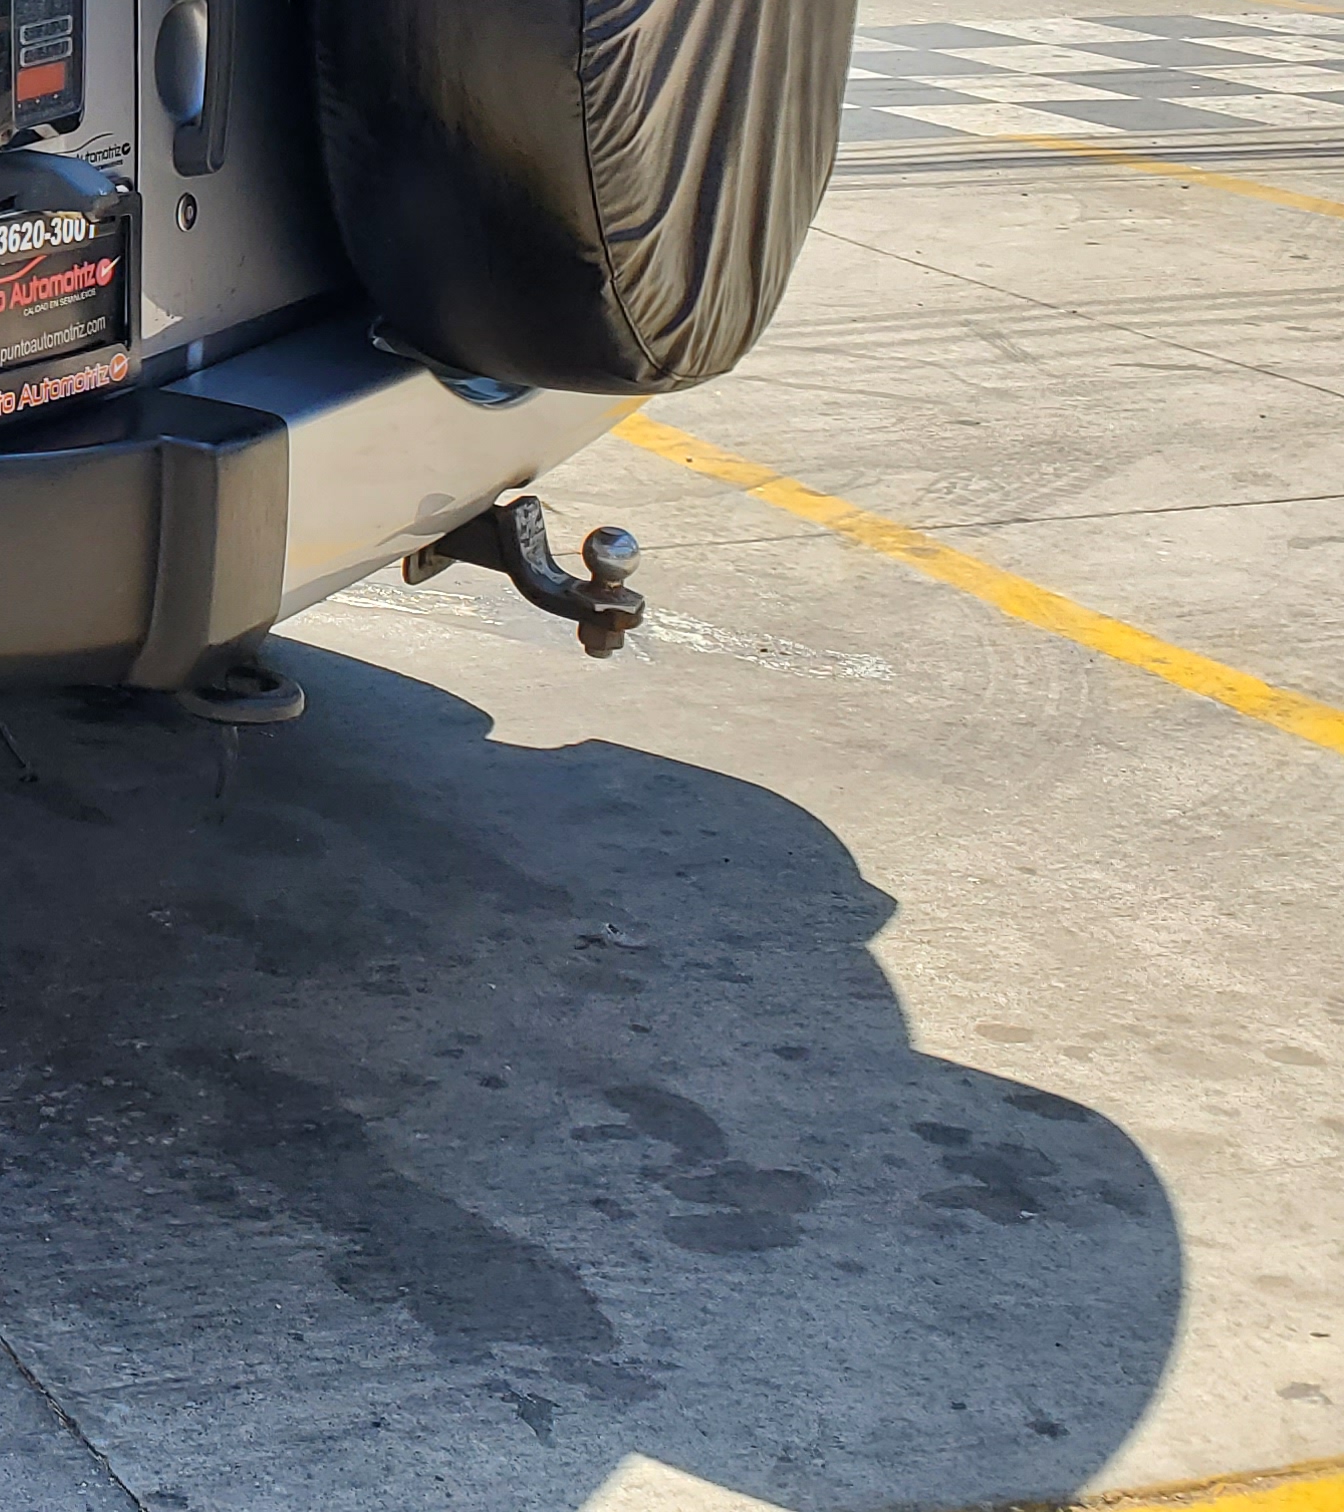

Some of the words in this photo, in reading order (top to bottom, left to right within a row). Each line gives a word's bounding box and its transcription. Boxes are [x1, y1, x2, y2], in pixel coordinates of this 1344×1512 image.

[9, 261, 96, 309] Automotriz
[23, 302, 48, 316] CALIDAD
[49, 299, 59, 309] EN
[17, 362, 110, 411] Automotriz
